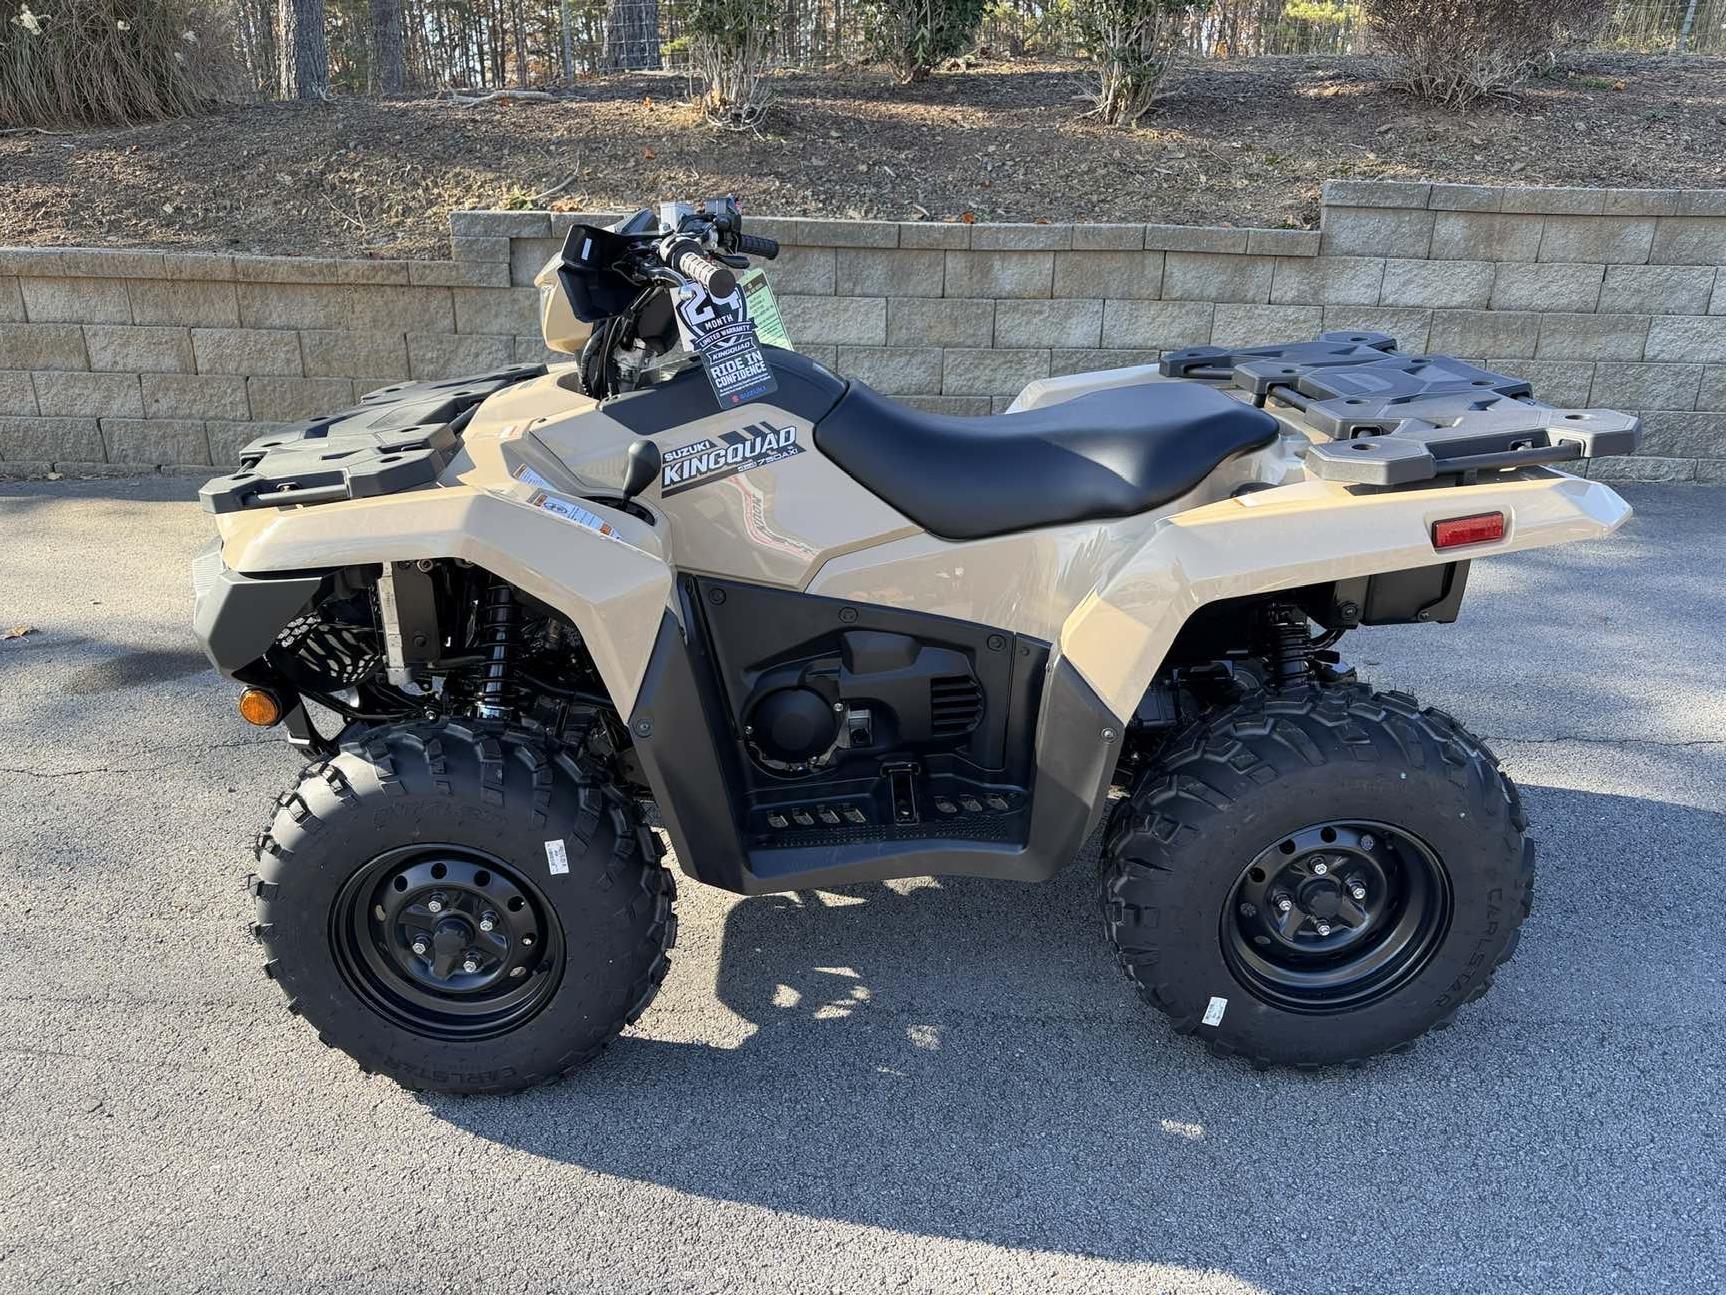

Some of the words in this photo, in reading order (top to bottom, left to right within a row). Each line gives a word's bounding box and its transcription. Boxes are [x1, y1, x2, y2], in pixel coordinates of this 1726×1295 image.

[704, 314, 734, 331] MONTH
[699, 331, 721, 348] LIMITED
[720, 324, 751, 337] WARRANTY
[711, 341, 751, 360] KINGQUAD
[710, 357, 745, 380] RIDE
[744, 350, 764, 366] IN
[714, 361, 767, 389] CONFIDENCE
[663, 425, 797, 486] KINGQUAD
[664, 440, 711, 462] SUZUKI
[1433, 887, 1503, 1007] CARLSTAR
